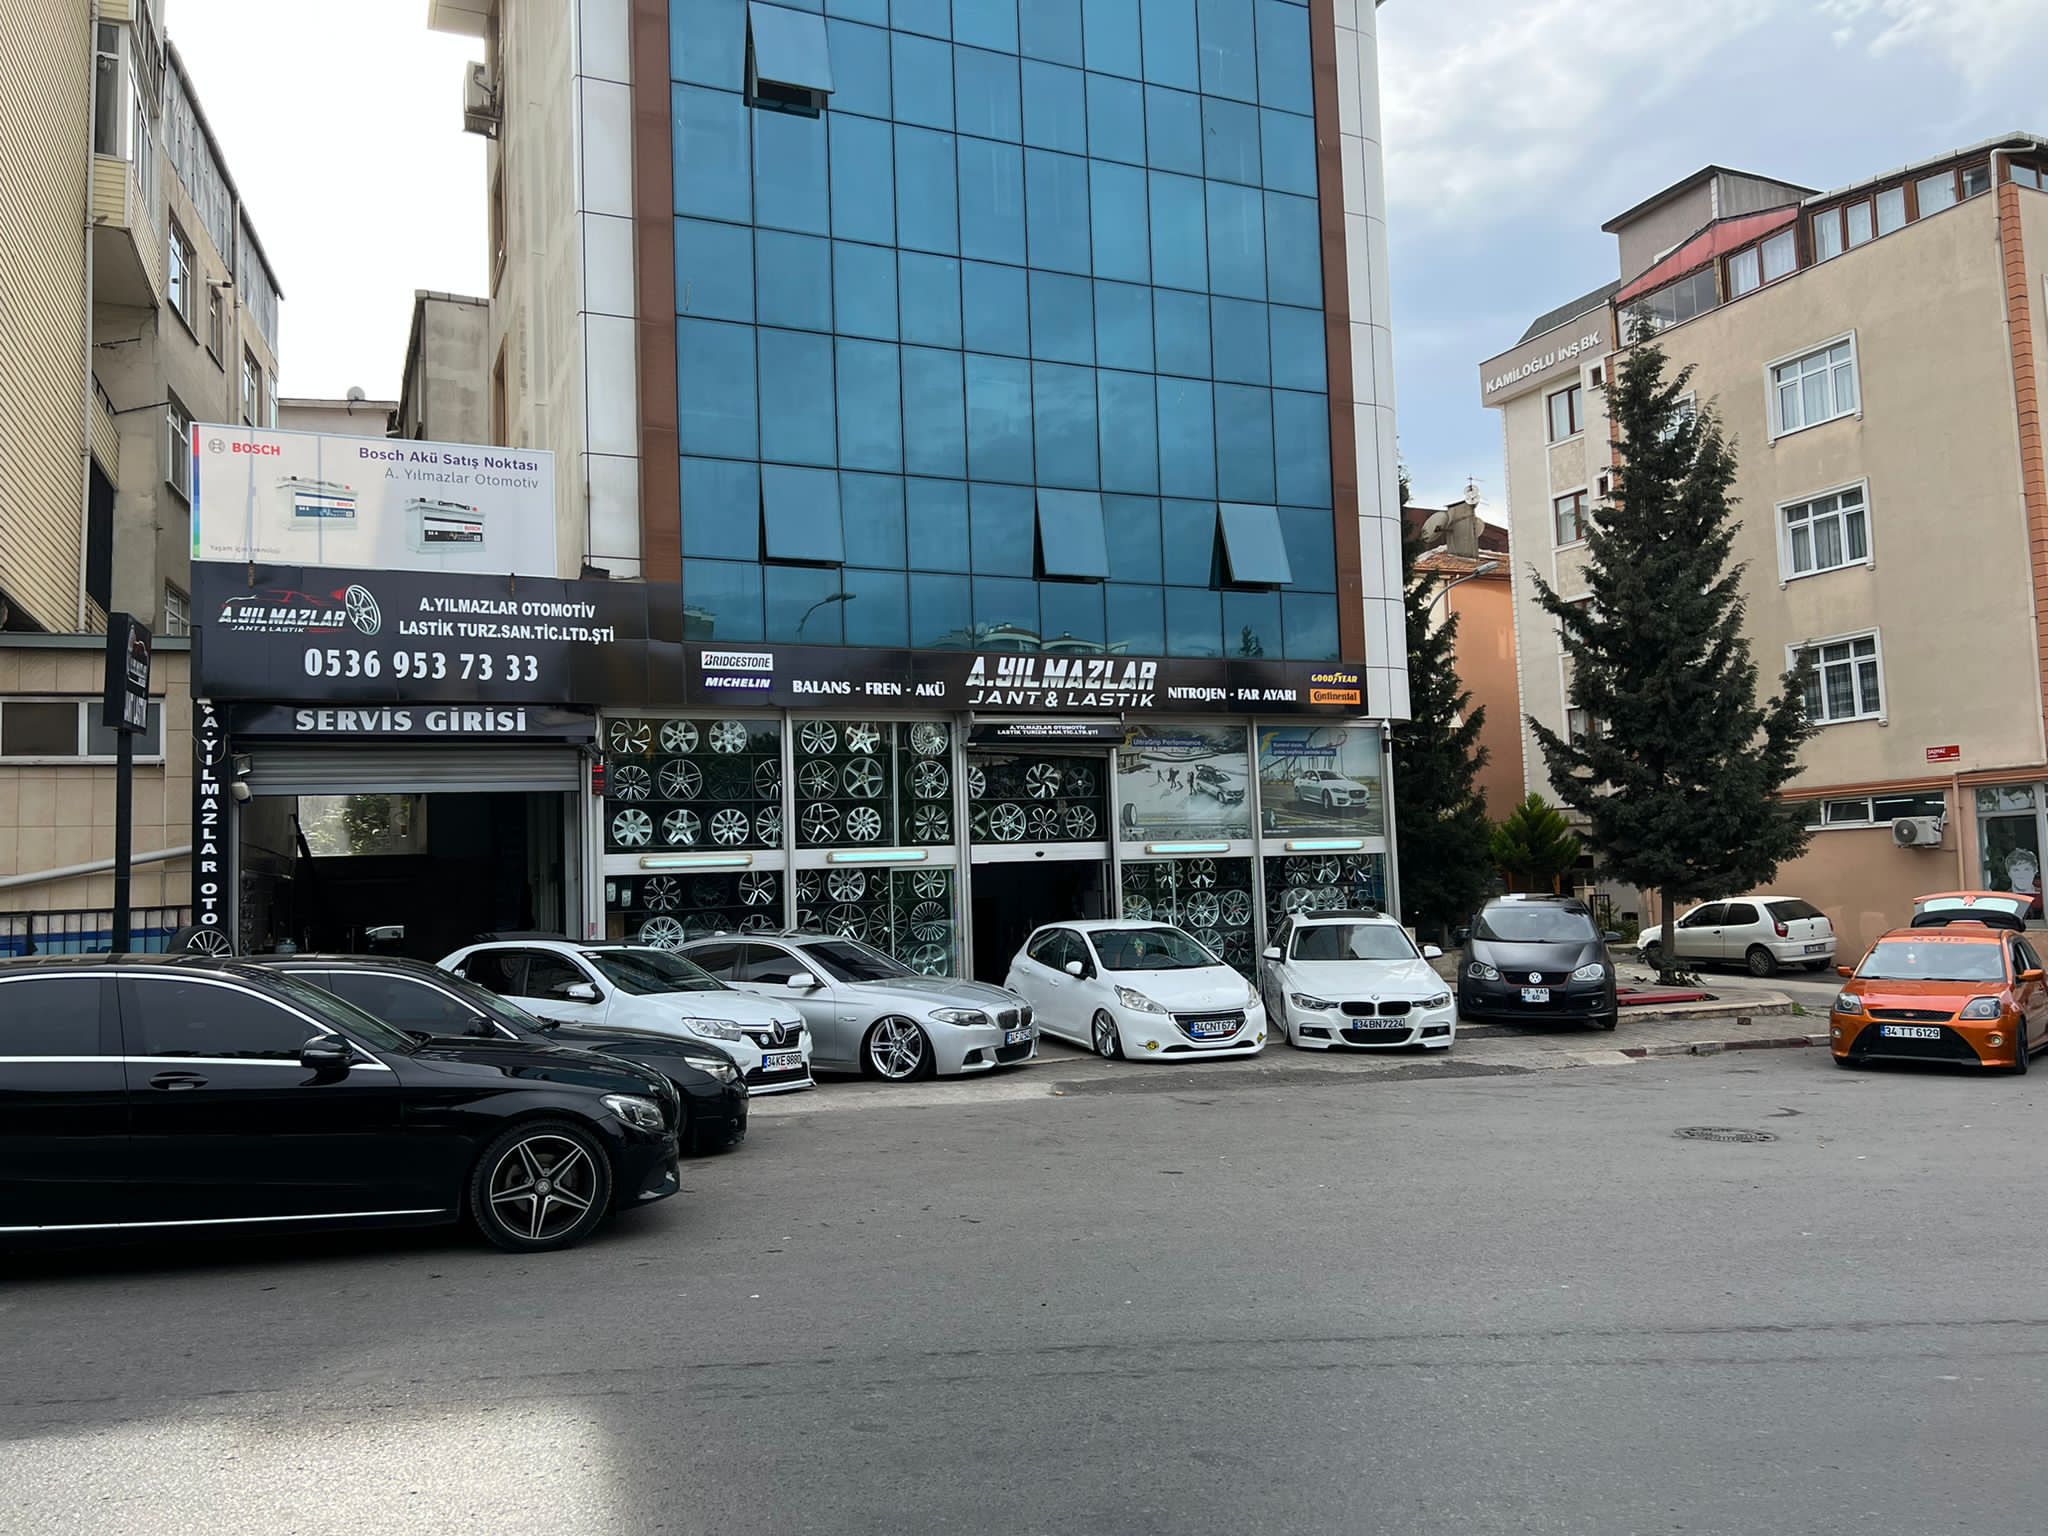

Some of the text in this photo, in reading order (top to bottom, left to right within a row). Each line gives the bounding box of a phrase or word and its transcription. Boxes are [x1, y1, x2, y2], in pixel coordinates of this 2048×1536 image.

[1485, 351, 1555, 394] KAMİLOĞLU
[232, 442, 281, 456] BOSCH
[359, 447, 538, 471] Bosch Akü Satış Noktası
[384, 468, 539, 489] A. Yılmazlar Otomotiv
[218, 606, 346, 627] A.YILMAZLAR
[419, 598, 595, 618] A.YILMAZLAR OTOMOTİV
[399, 619, 614, 644] LASTİK TURZ.SAN.TİC.LTD.ŞTİ
[304, 648, 539, 681] 0536 953 73 33
[704, 653, 771, 668] BRIDGESTONE
[705, 677, 771, 688] MICHELIN
[965, 656, 1157, 690] A.YILMAZLAR
[1311, 672, 1358, 684] GOODYEAR
[792, 680, 851, 694] BALANS
[865, 682, 902, 695] FREN
[915, 681, 945, 696] AKÜ
[1168, 687, 1226, 701] NITROJEN
[1237, 688, 1260, 700] FAR
[1263, 690, 1296, 701] AYARI
[1313, 691, 1357, 701] Continental
[968, 690, 1041, 705] JANT
[1045, 692, 1058, 707] &
[296, 706, 526, 731] SERVİS GİRİSİ
[200, 882, 218, 925] OTO
